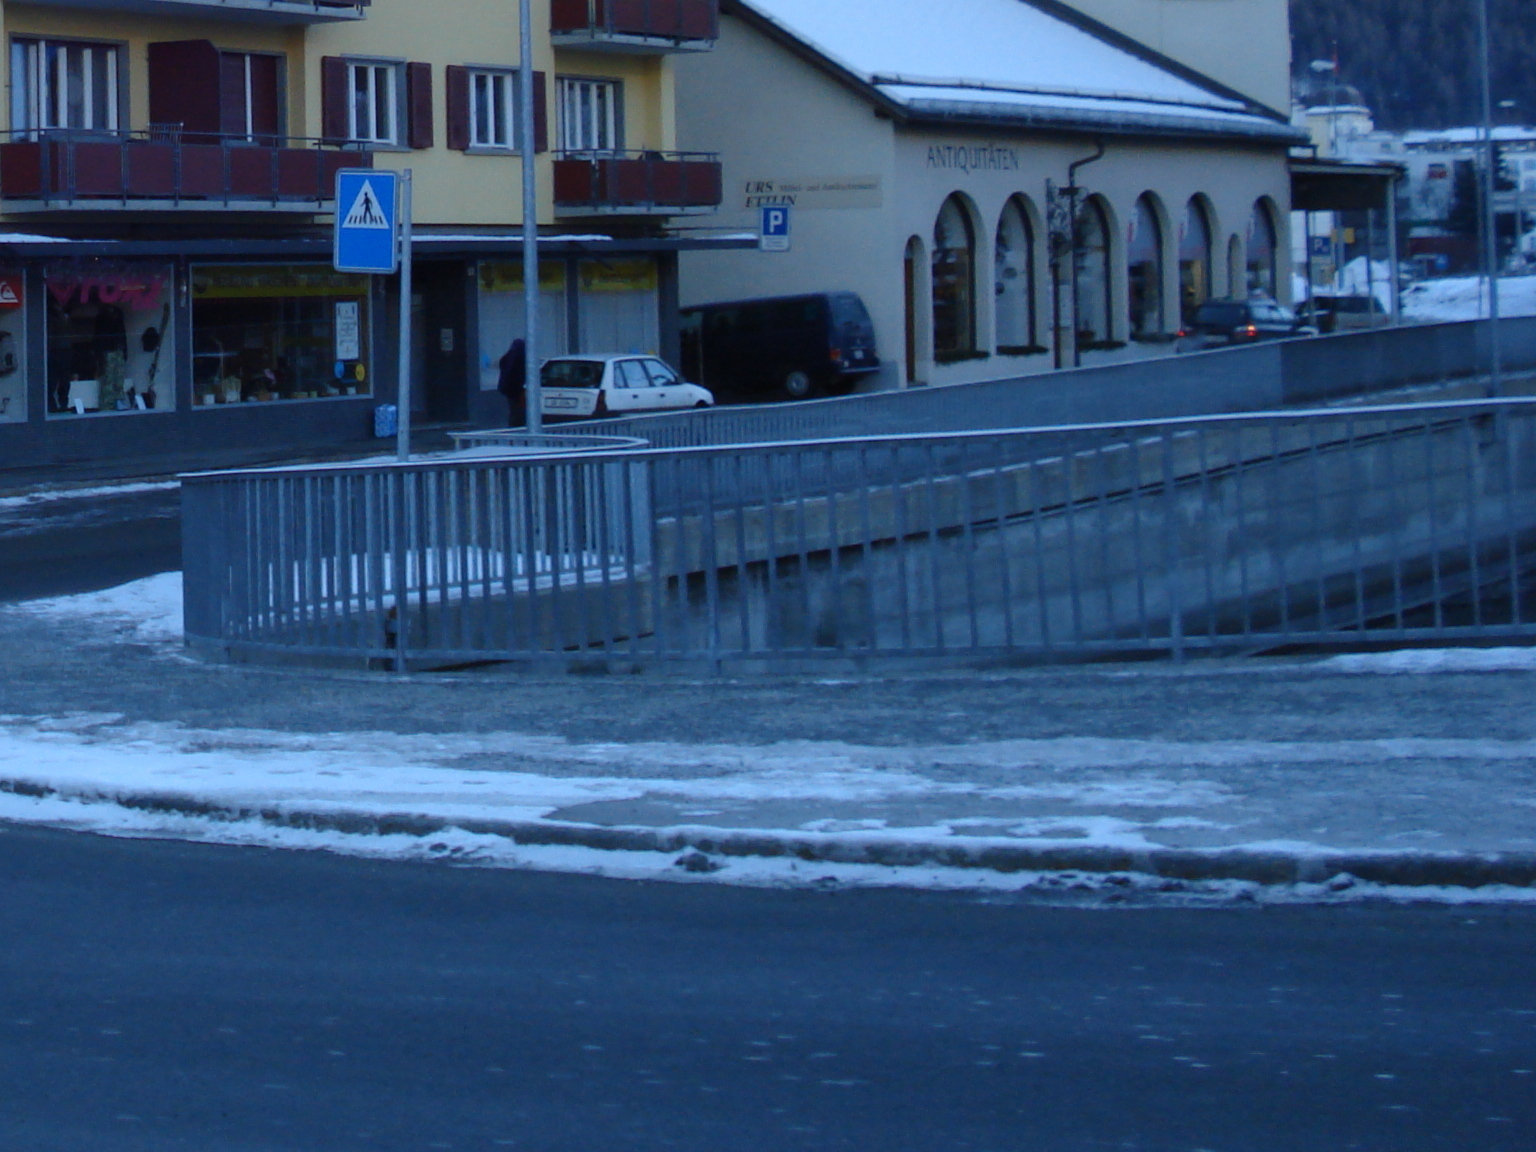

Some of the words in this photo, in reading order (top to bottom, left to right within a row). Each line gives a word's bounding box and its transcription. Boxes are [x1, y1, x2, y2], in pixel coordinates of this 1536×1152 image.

[927, 144, 1019, 175] ANTIQUITÄTEN
[745, 180, 774, 193] URS
[769, 210, 783, 233] P
